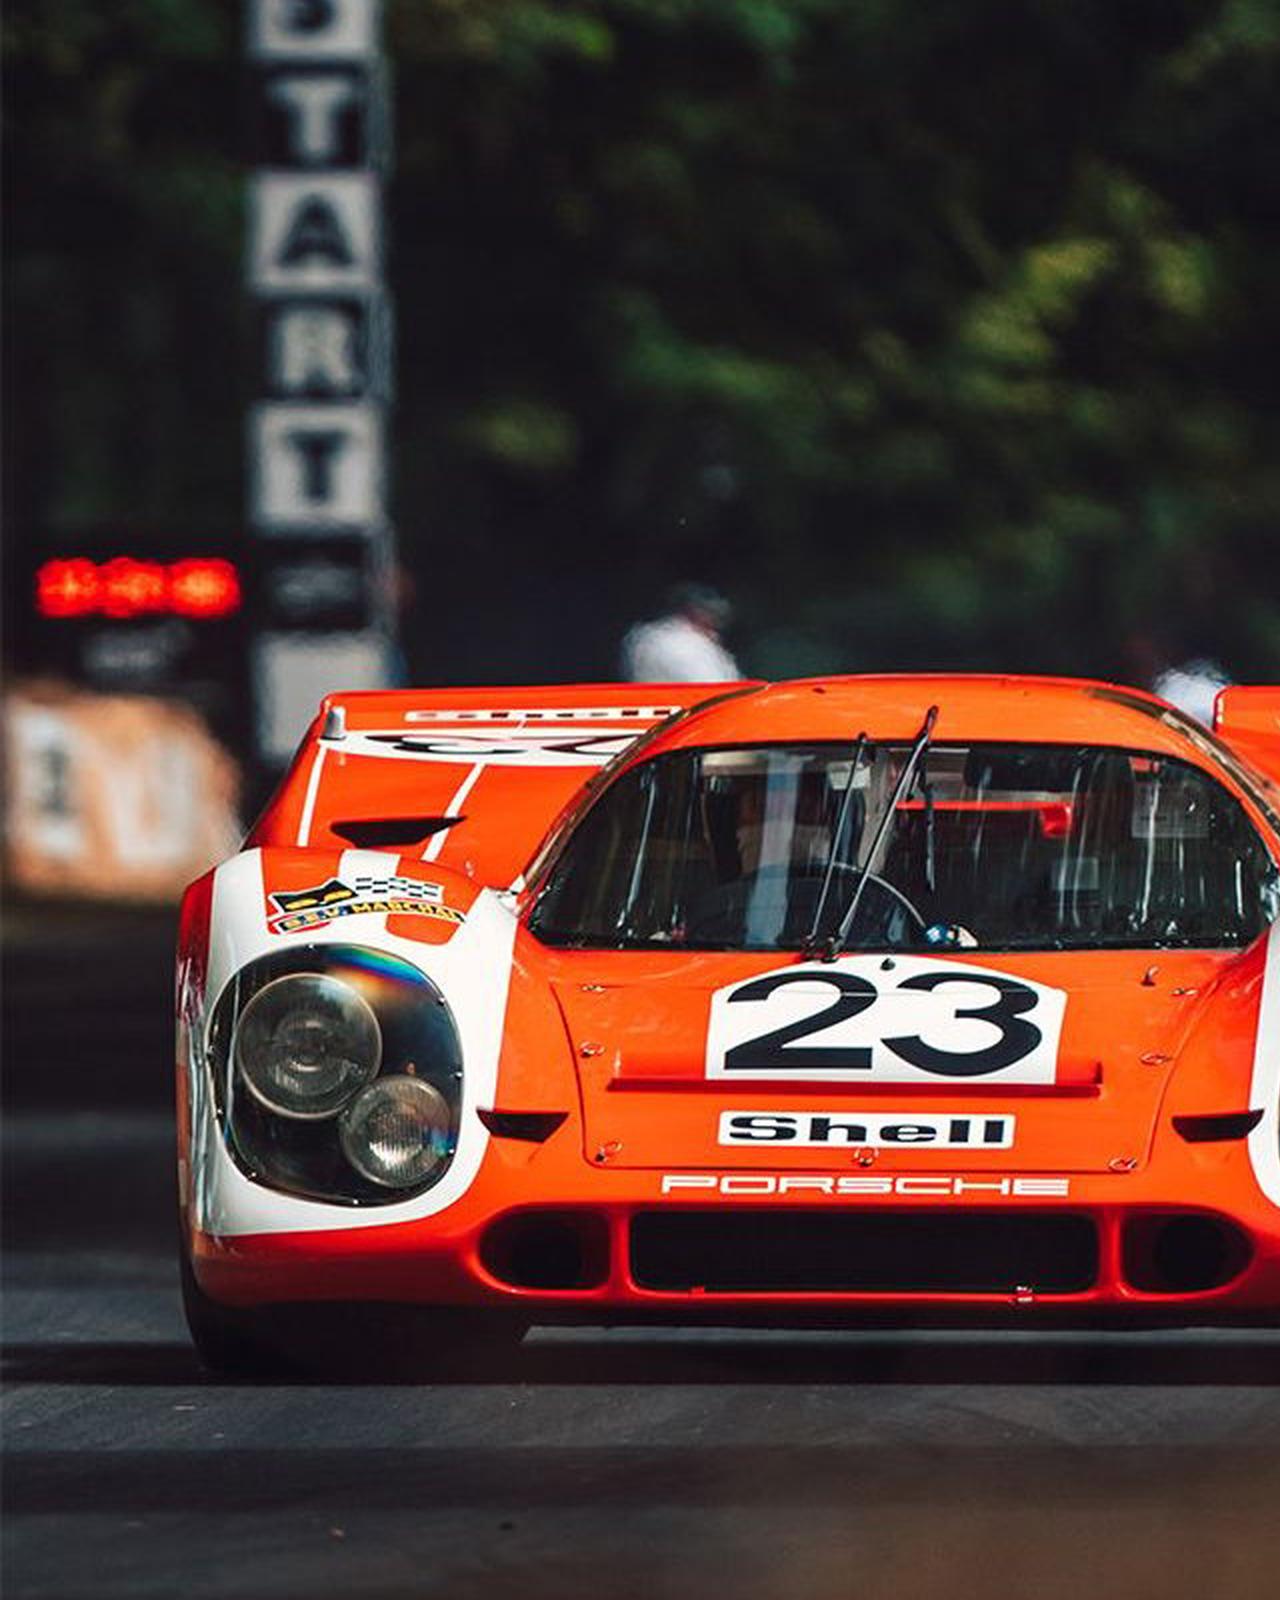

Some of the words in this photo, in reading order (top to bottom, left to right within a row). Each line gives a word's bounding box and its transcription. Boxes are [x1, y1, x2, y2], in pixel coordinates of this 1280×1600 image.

[724, 970, 1043, 1077] 23
[729, 1116, 1005, 1143] Shell
[661, 1175, 1069, 1196] PORSCHE
